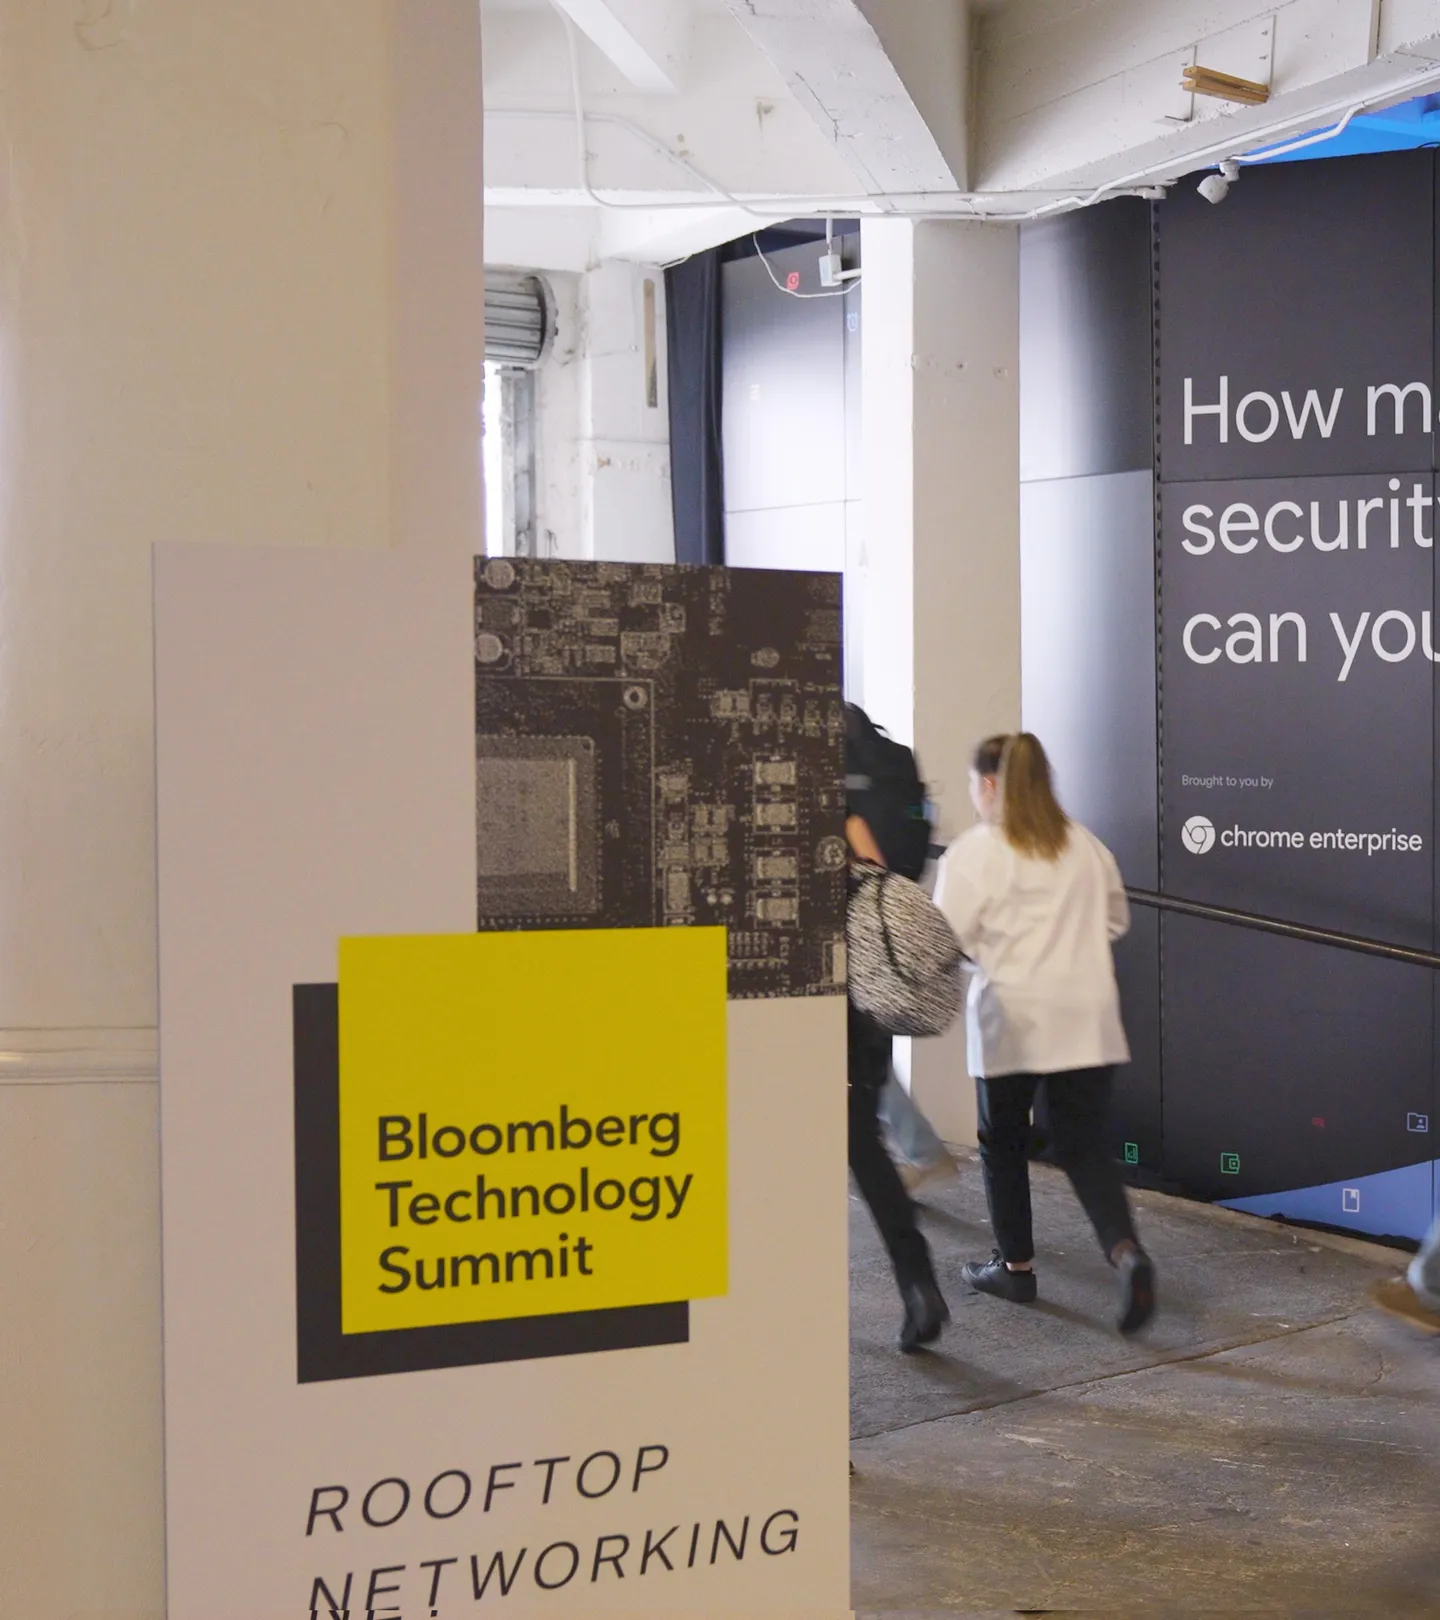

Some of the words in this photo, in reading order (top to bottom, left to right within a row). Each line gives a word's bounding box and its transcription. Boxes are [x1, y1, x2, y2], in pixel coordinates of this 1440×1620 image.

[1183, 375, 1344, 445] How
[1182, 611, 1307, 665] can
[1181, 774, 1224, 789] Brought
[1225, 775, 1237, 787] to
[1238, 777, 1258, 789] you
[1260, 776, 1274, 790] by
[1220, 824, 1305, 849] chrome
[1309, 827, 1423, 857] enterprise
[376, 1104, 681, 1162] Bloomberg
[375, 1168, 693, 1228] Technology
[376, 1233, 594, 1294] Summit
[305, 1444, 669, 1537] ROOFTOP
[308, 1509, 800, 1620] NETWORKING
